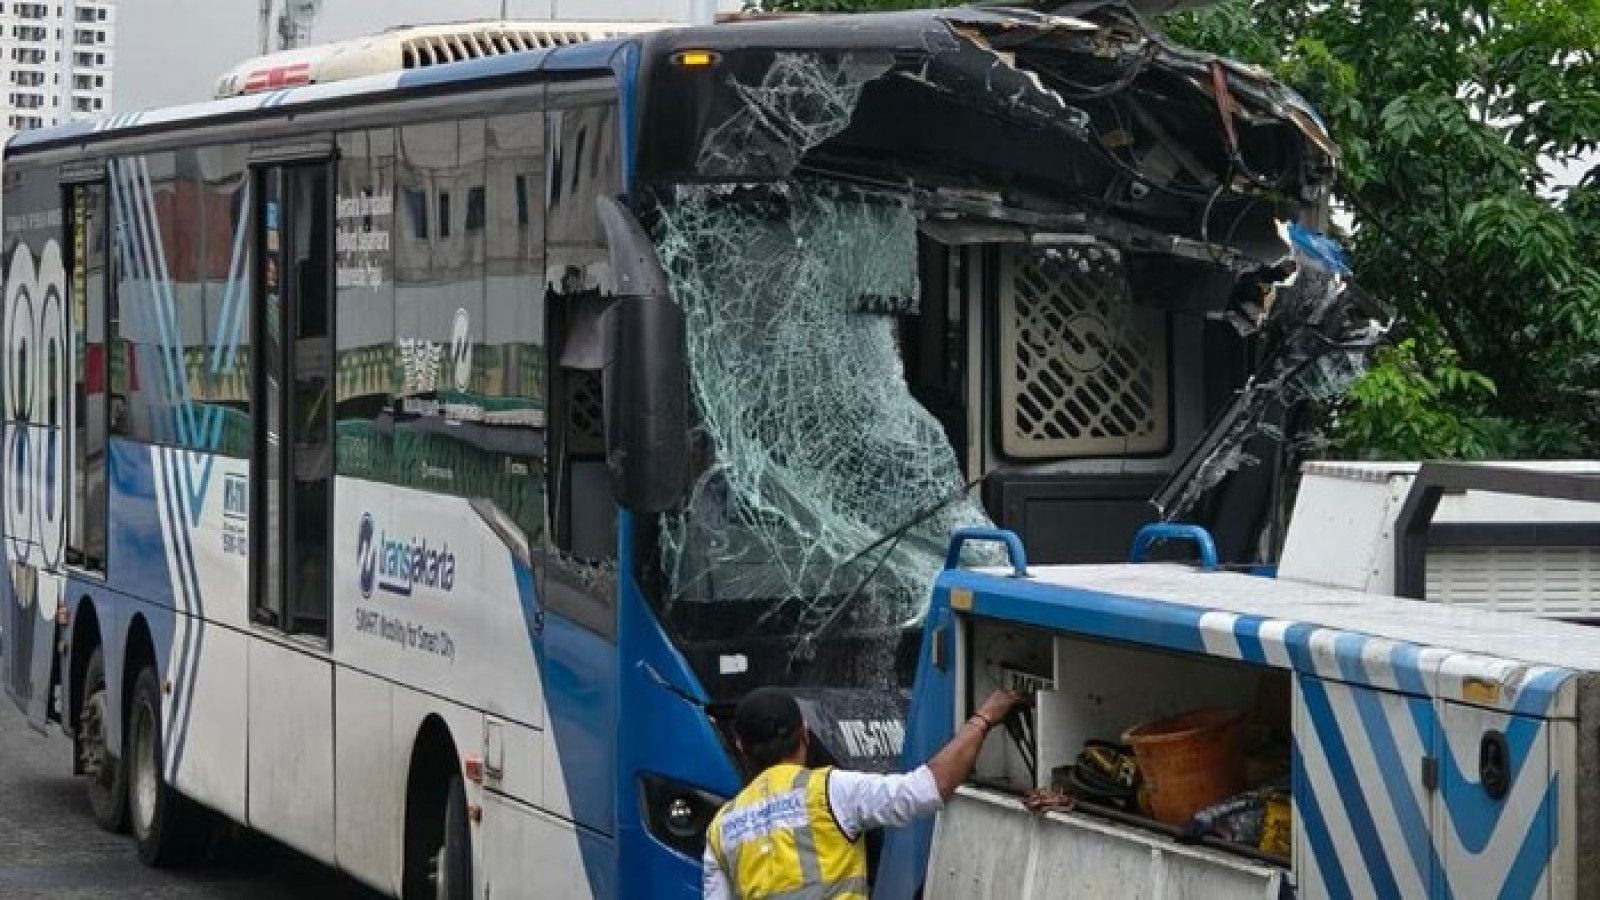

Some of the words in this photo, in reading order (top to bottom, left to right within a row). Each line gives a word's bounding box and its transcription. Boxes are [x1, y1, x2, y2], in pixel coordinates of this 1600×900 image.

[379, 529, 456, 596] transjakarta
[356, 607, 378, 635] SMART
[380, 615, 406, 651] Mobility
[407, 621, 418, 648] for
[418, 625, 440, 654] Smart
